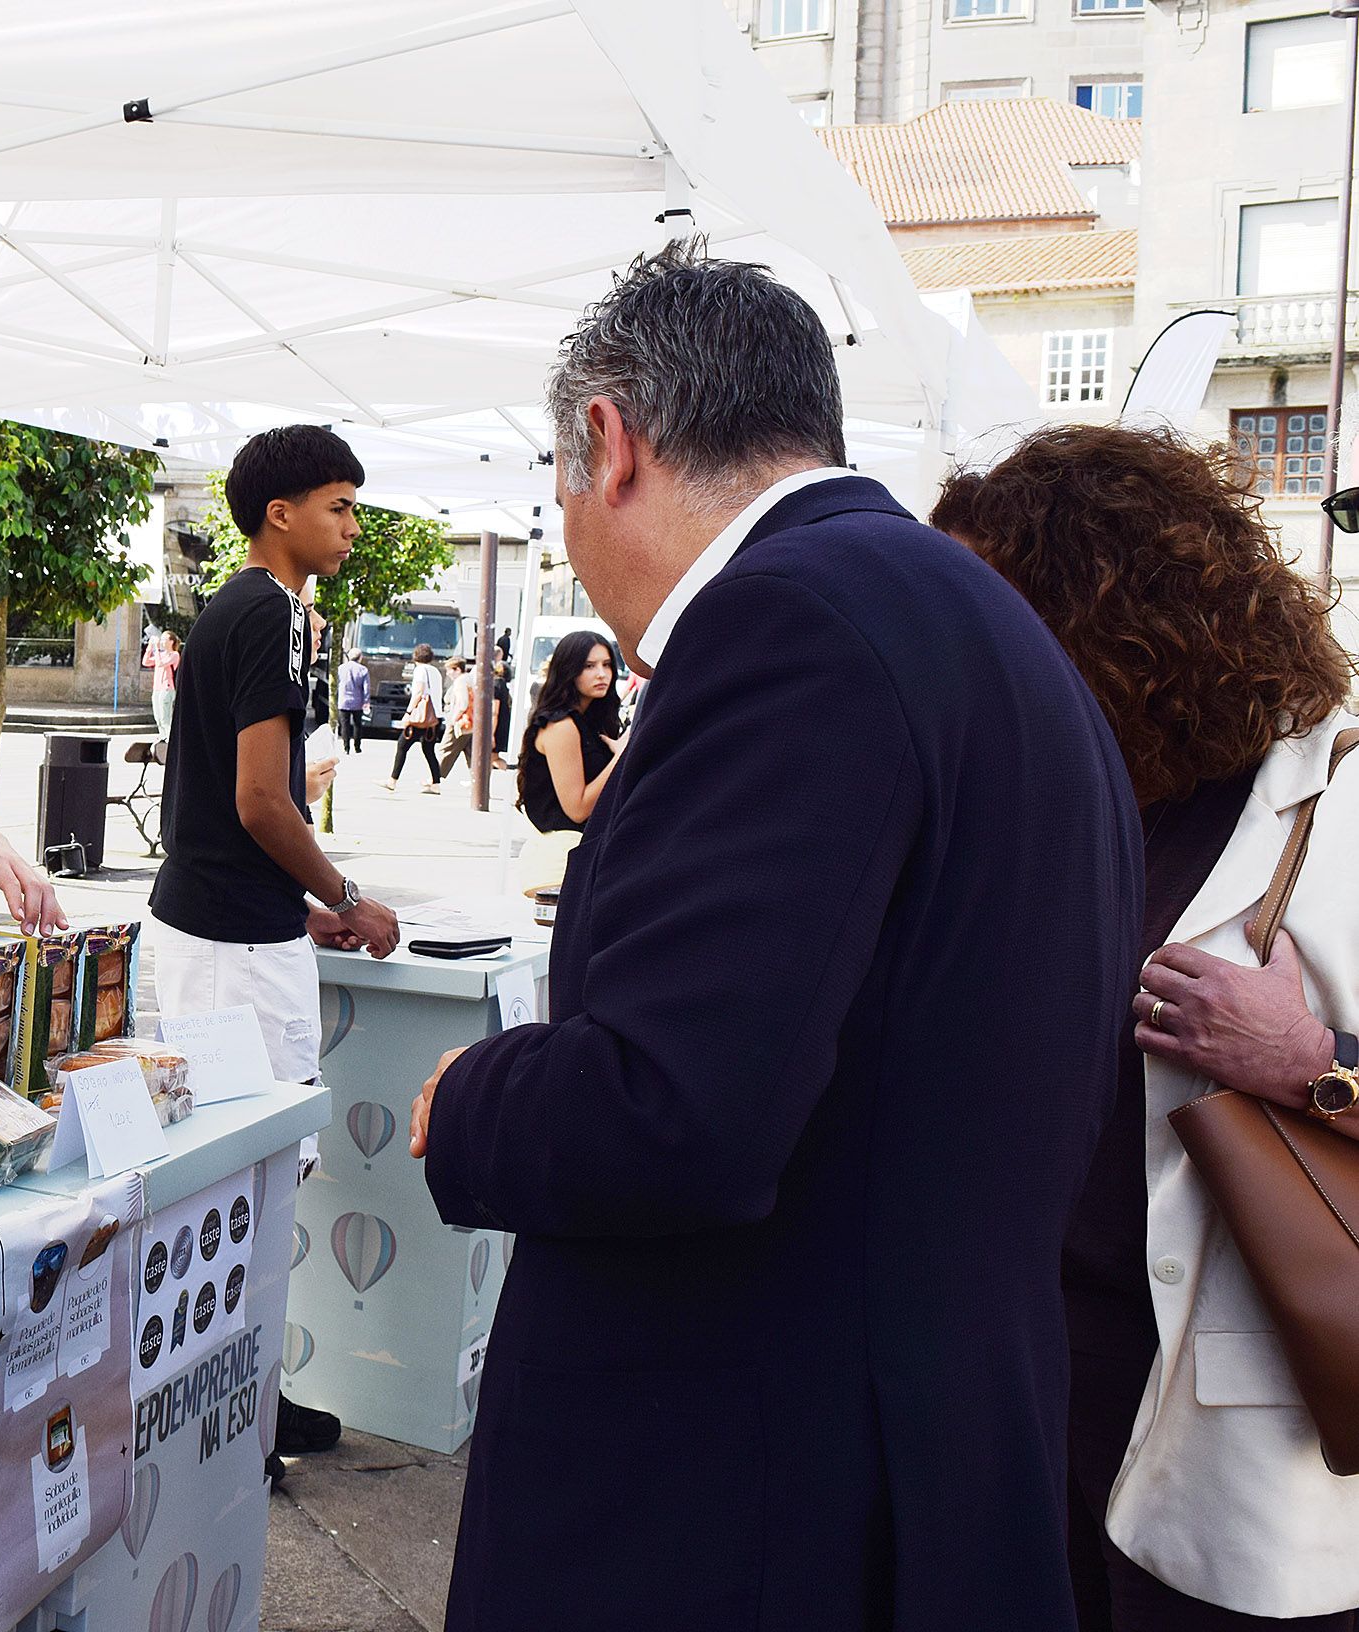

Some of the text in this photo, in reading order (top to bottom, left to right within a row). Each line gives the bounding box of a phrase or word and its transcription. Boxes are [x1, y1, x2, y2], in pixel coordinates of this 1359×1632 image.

[231, 1212, 249, 1231] taste
[201, 1226, 220, 1247] taste
[146, 1259, 167, 1280] taste
[194, 1298, 215, 1321] taste
[141, 1332, 162, 1355] taste
[134, 1324, 262, 1461] EPOEMPRENDE
[199, 1380, 258, 1465] NA ESO
[45, 1472, 79, 1503] Sobao de
